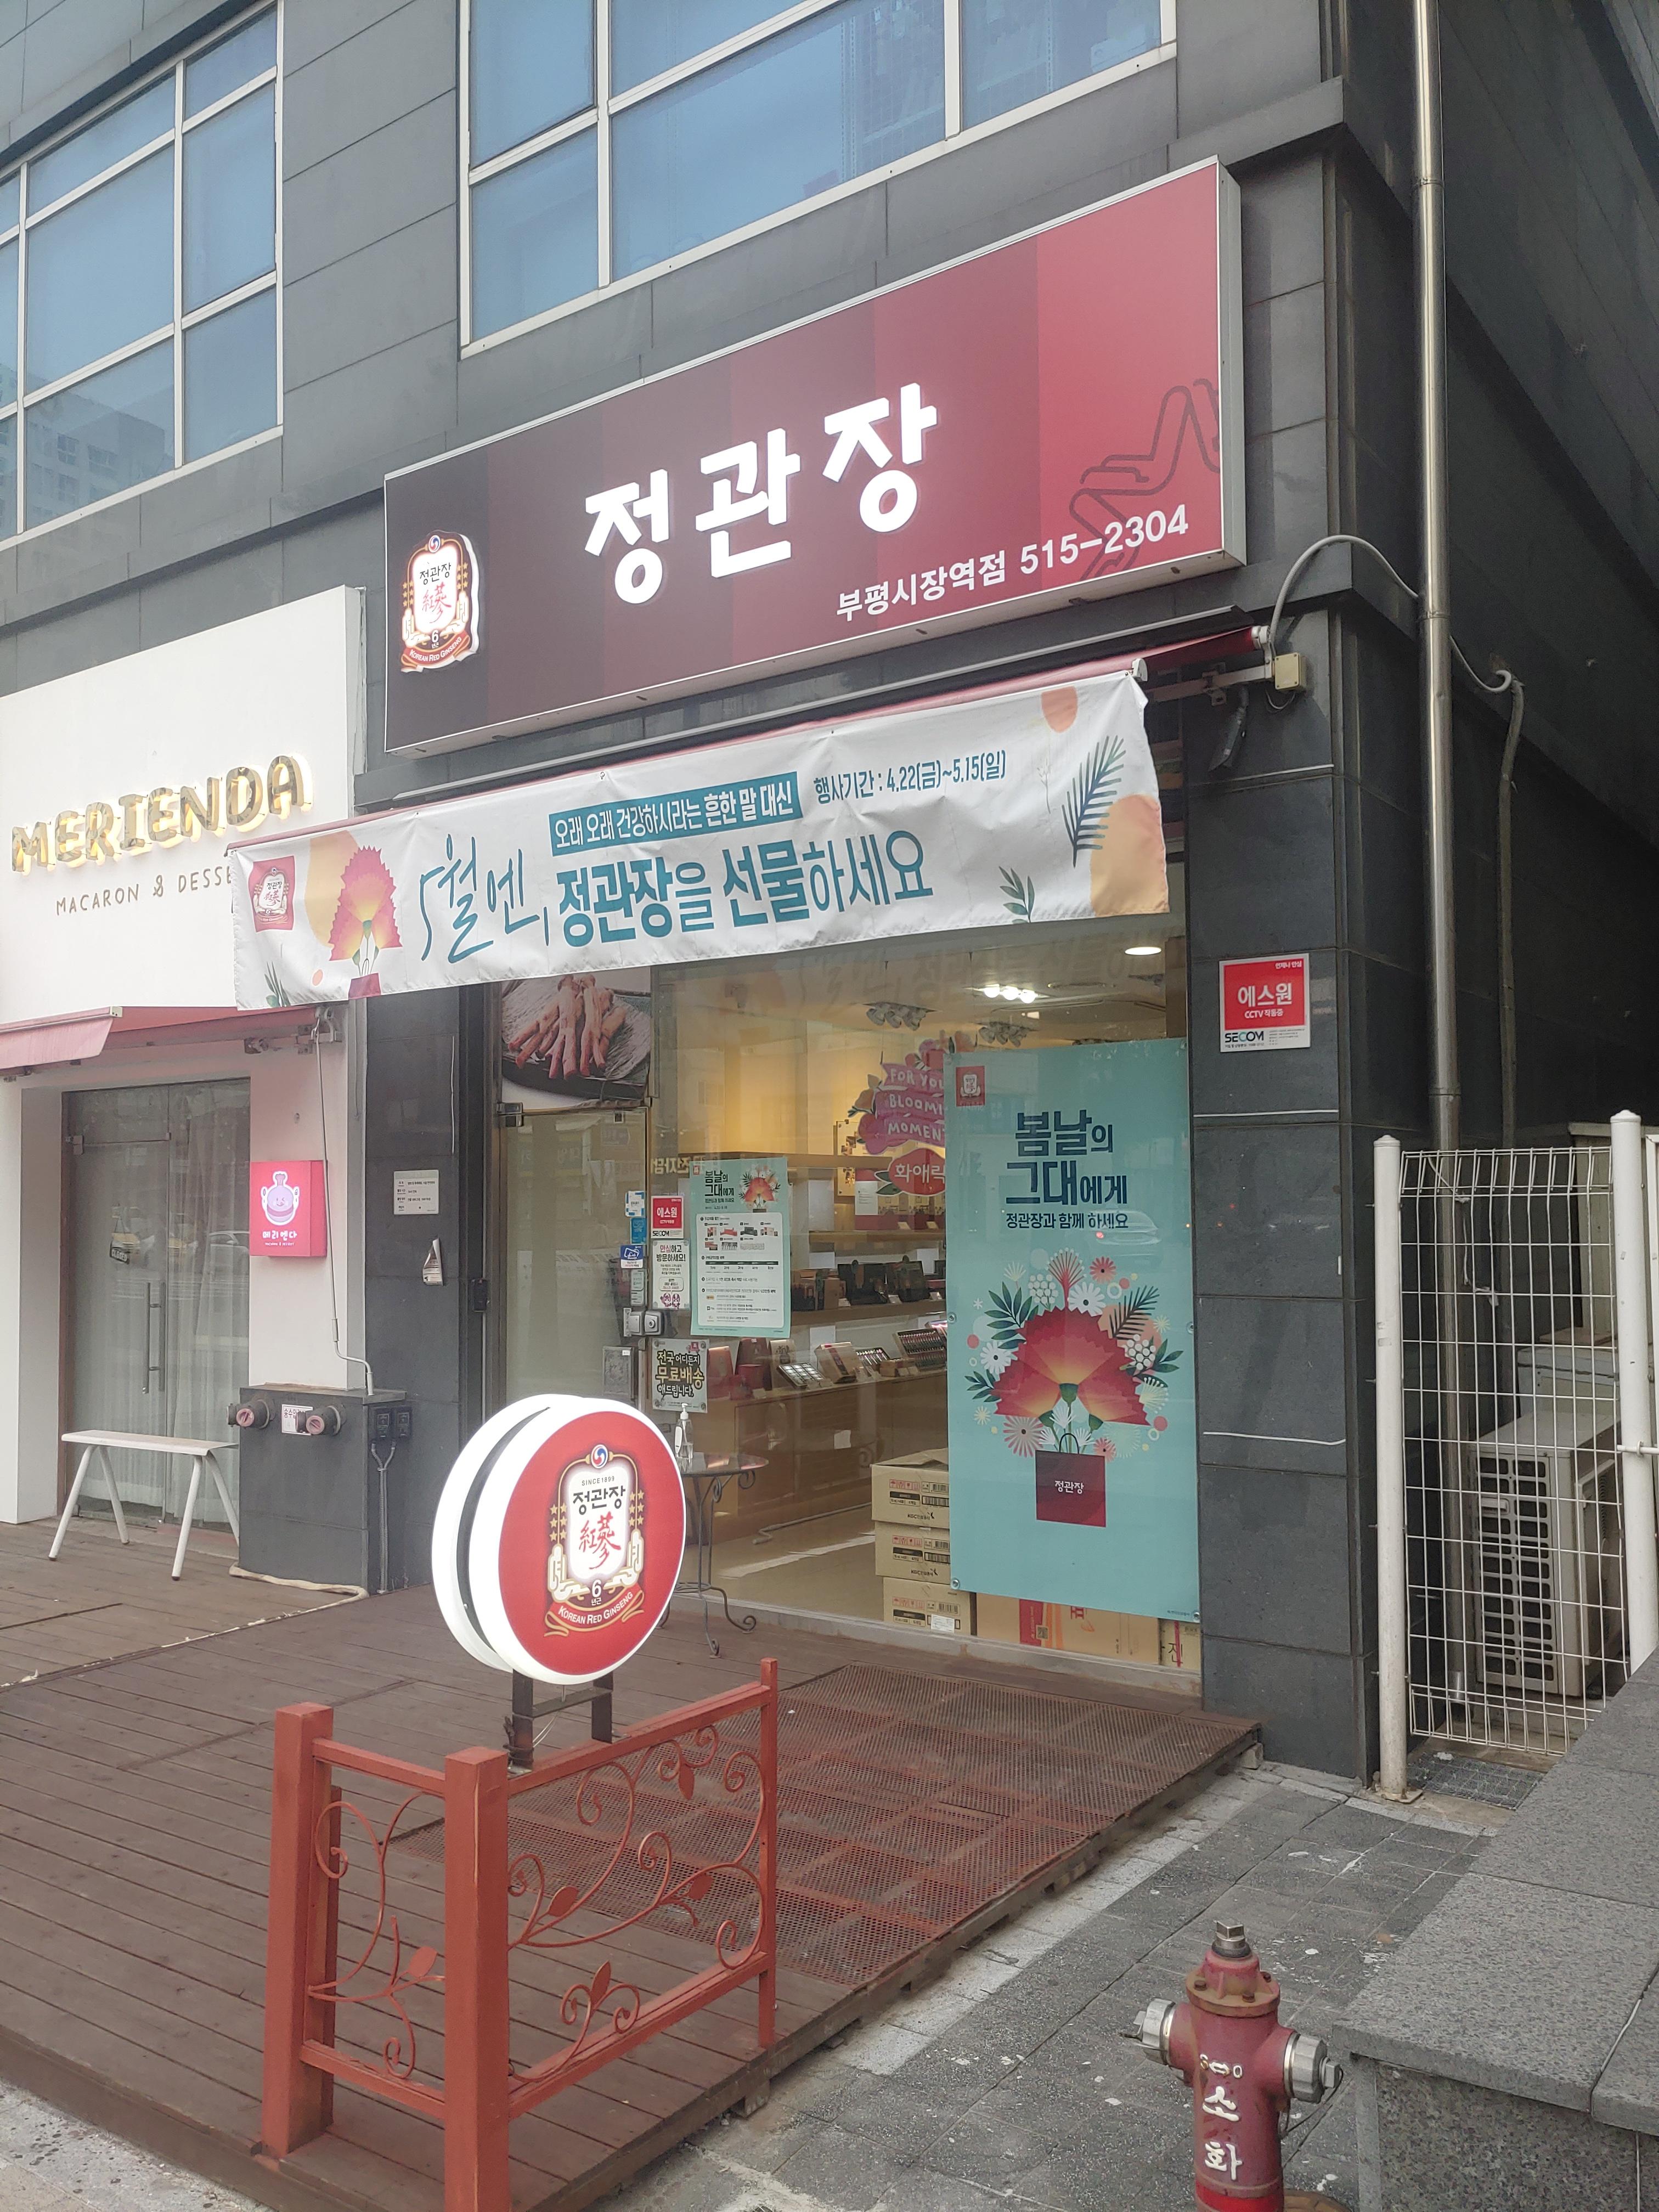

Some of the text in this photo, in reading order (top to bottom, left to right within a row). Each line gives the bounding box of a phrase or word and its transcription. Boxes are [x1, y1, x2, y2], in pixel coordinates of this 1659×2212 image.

[584, 382, 937, 604] 정관장
[837, 504, 1189, 622] 부평시장역점 515-2304
[419, 562, 452, 585] 정관장
[431, 629, 439, 643] 6
[409, 636, 462, 662] KOREAN RED GINSENG
[813, 770, 874, 805] 행사기간
[11, 755, 305, 872] MERIENDA
[555, 781, 794, 849] 오래 오래 건강하시라는 흔한 말 대신
[266, 881, 283, 890] 정관장
[556, 856, 715, 948] 정관장을
[721, 830, 934, 928] 선물하세요
[57, 883, 139, 916] MACARON
[1237, 983, 1293, 1007] 에스원
[1244, 1010, 1263, 1019] CCTV
[1224, 1031, 1264, 1043] SECOM
[890, 1068, 915, 1085] FOR
[1015, 1109, 1114, 1156] 봄날의
[704, 1170, 728, 1183] 봄날의
[1006, 1160, 1128, 1206] 그대에게
[704, 1183, 735, 1197] 그대에게
[657, 1207, 678, 1218] 에스원
[1006, 1212, 1128, 1229] 정관장과 함께 하세요
[262, 1230, 298, 1241] 메리엔다
[656, 1254, 686, 1262] 방문하세요!
[660, 1245, 682, 1253] 안심하고
[658, 1350, 700, 1366] 전국 어디든지
[656, 1366, 704, 1389] 무료배송
[582, 1478, 600, 1486] SINCE
[1054, 1480, 1085, 1496] 정관장
[573, 1485, 626, 1515] 정관장
[591, 1579, 602, 1598] 6
[557, 1592, 634, 1624] KOREAN RED GINSENG
[591, 1597, 602, 1606] 년근
